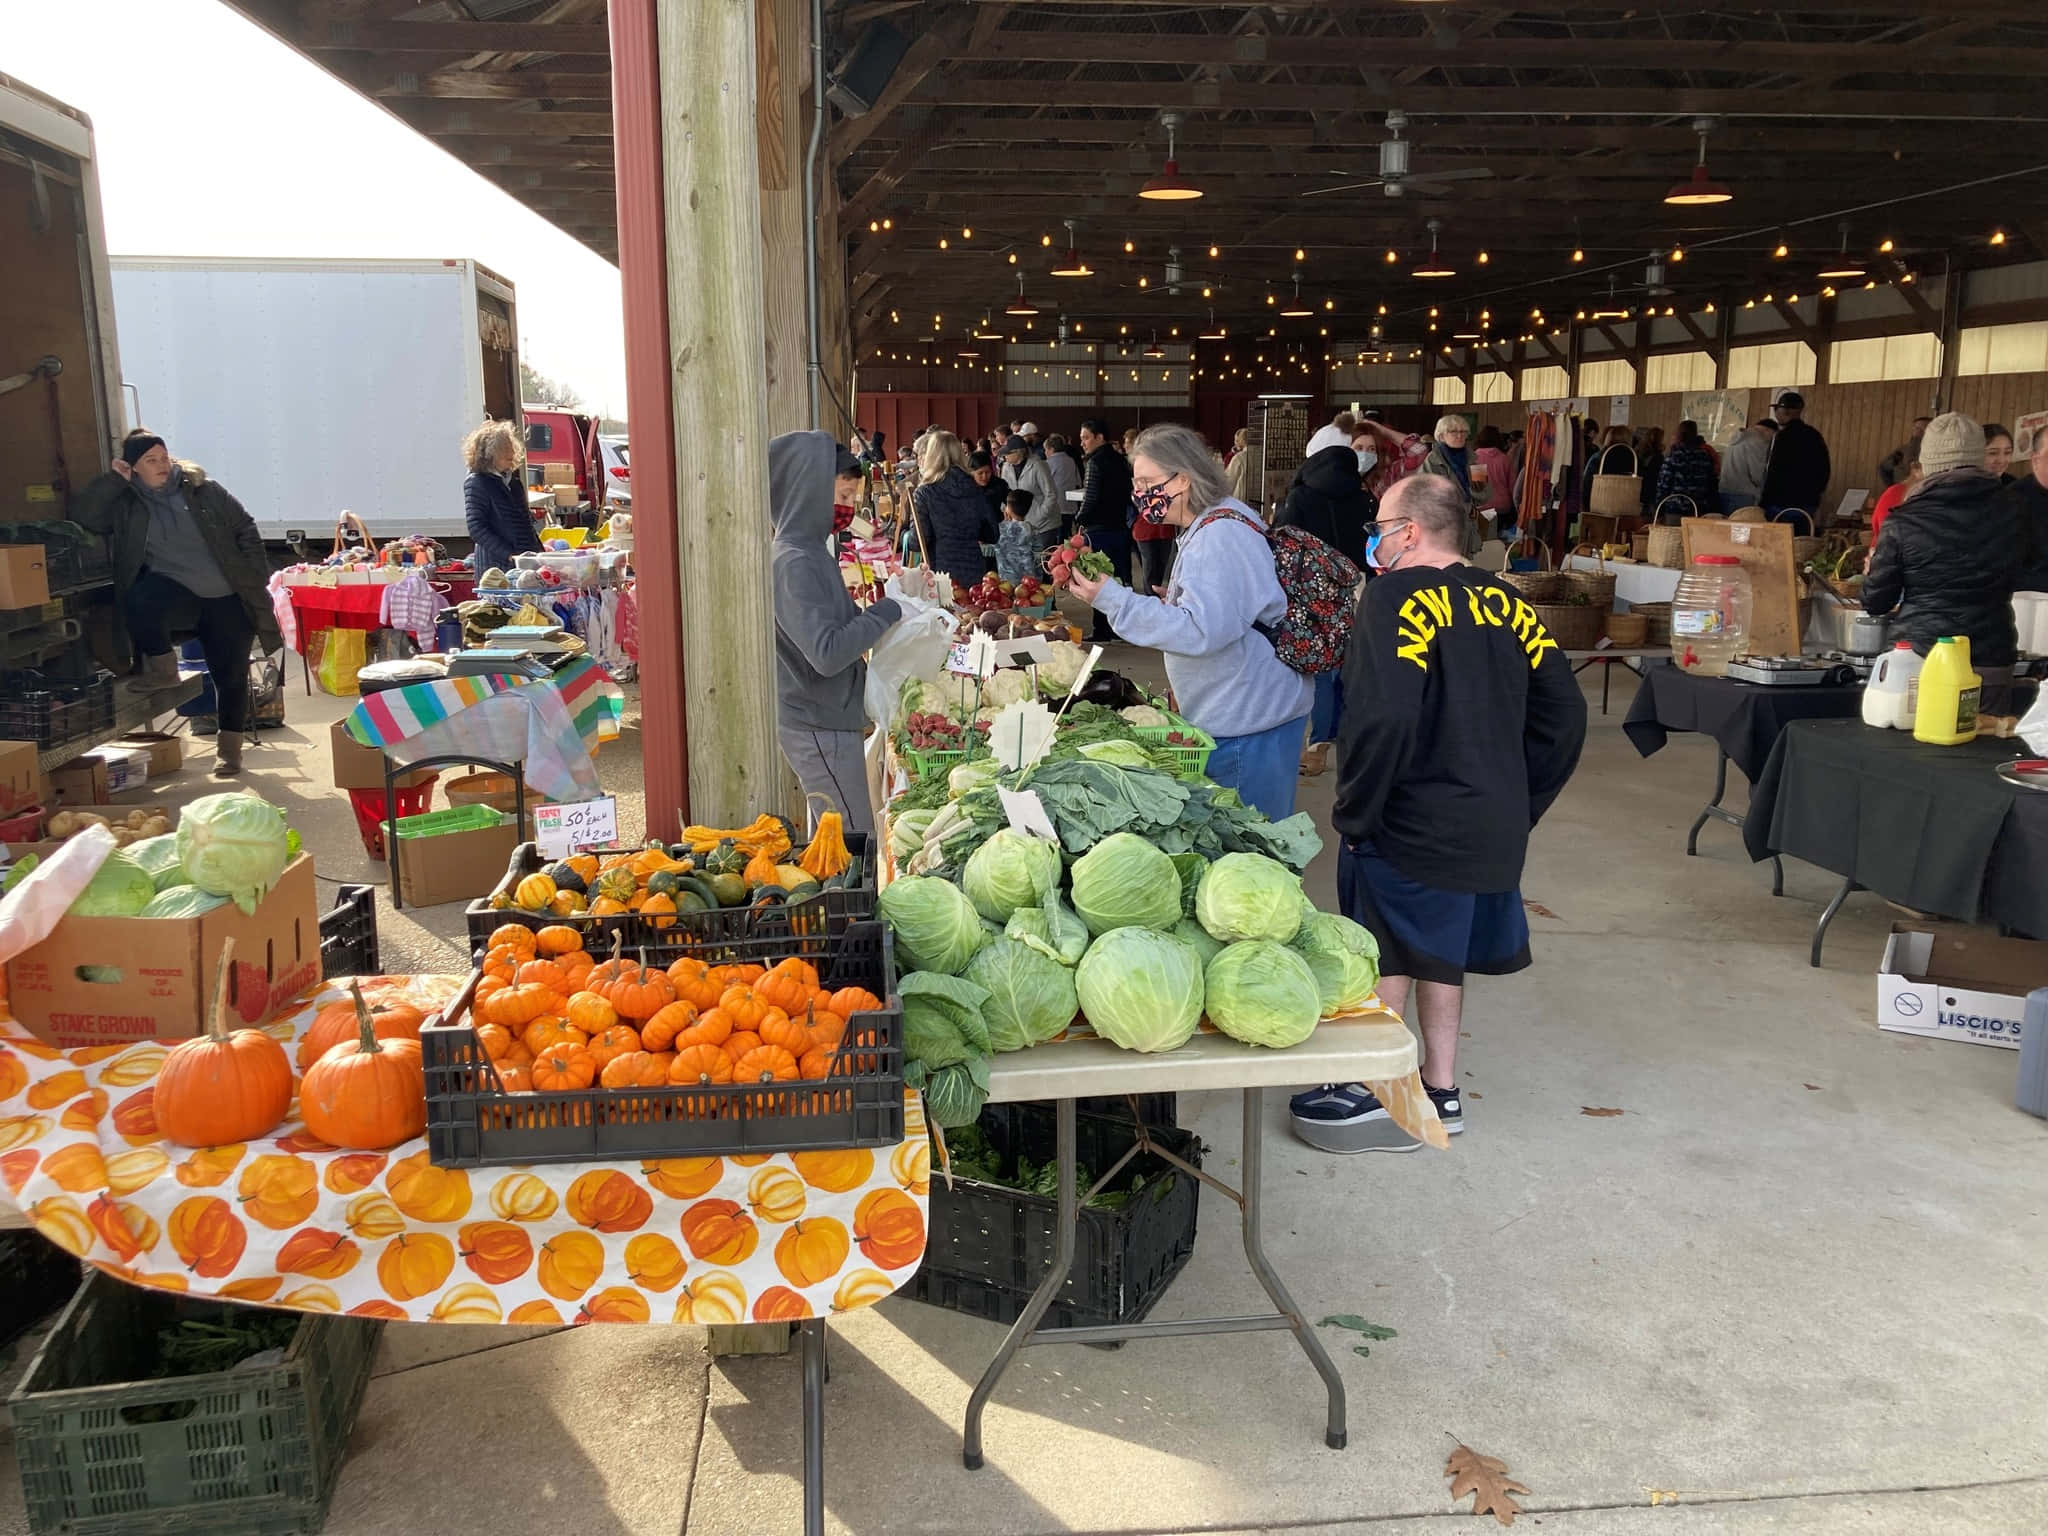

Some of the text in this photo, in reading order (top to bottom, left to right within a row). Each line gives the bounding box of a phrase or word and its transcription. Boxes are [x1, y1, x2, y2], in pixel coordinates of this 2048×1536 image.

[1396, 585, 1560, 673] NEW YORK
[586, 812, 607, 825] EACH
[155, 978, 169, 987] OF
[48, 1012, 158, 1036] STAKE GROWN
[1938, 1012, 2021, 1034] LISCIO'S
